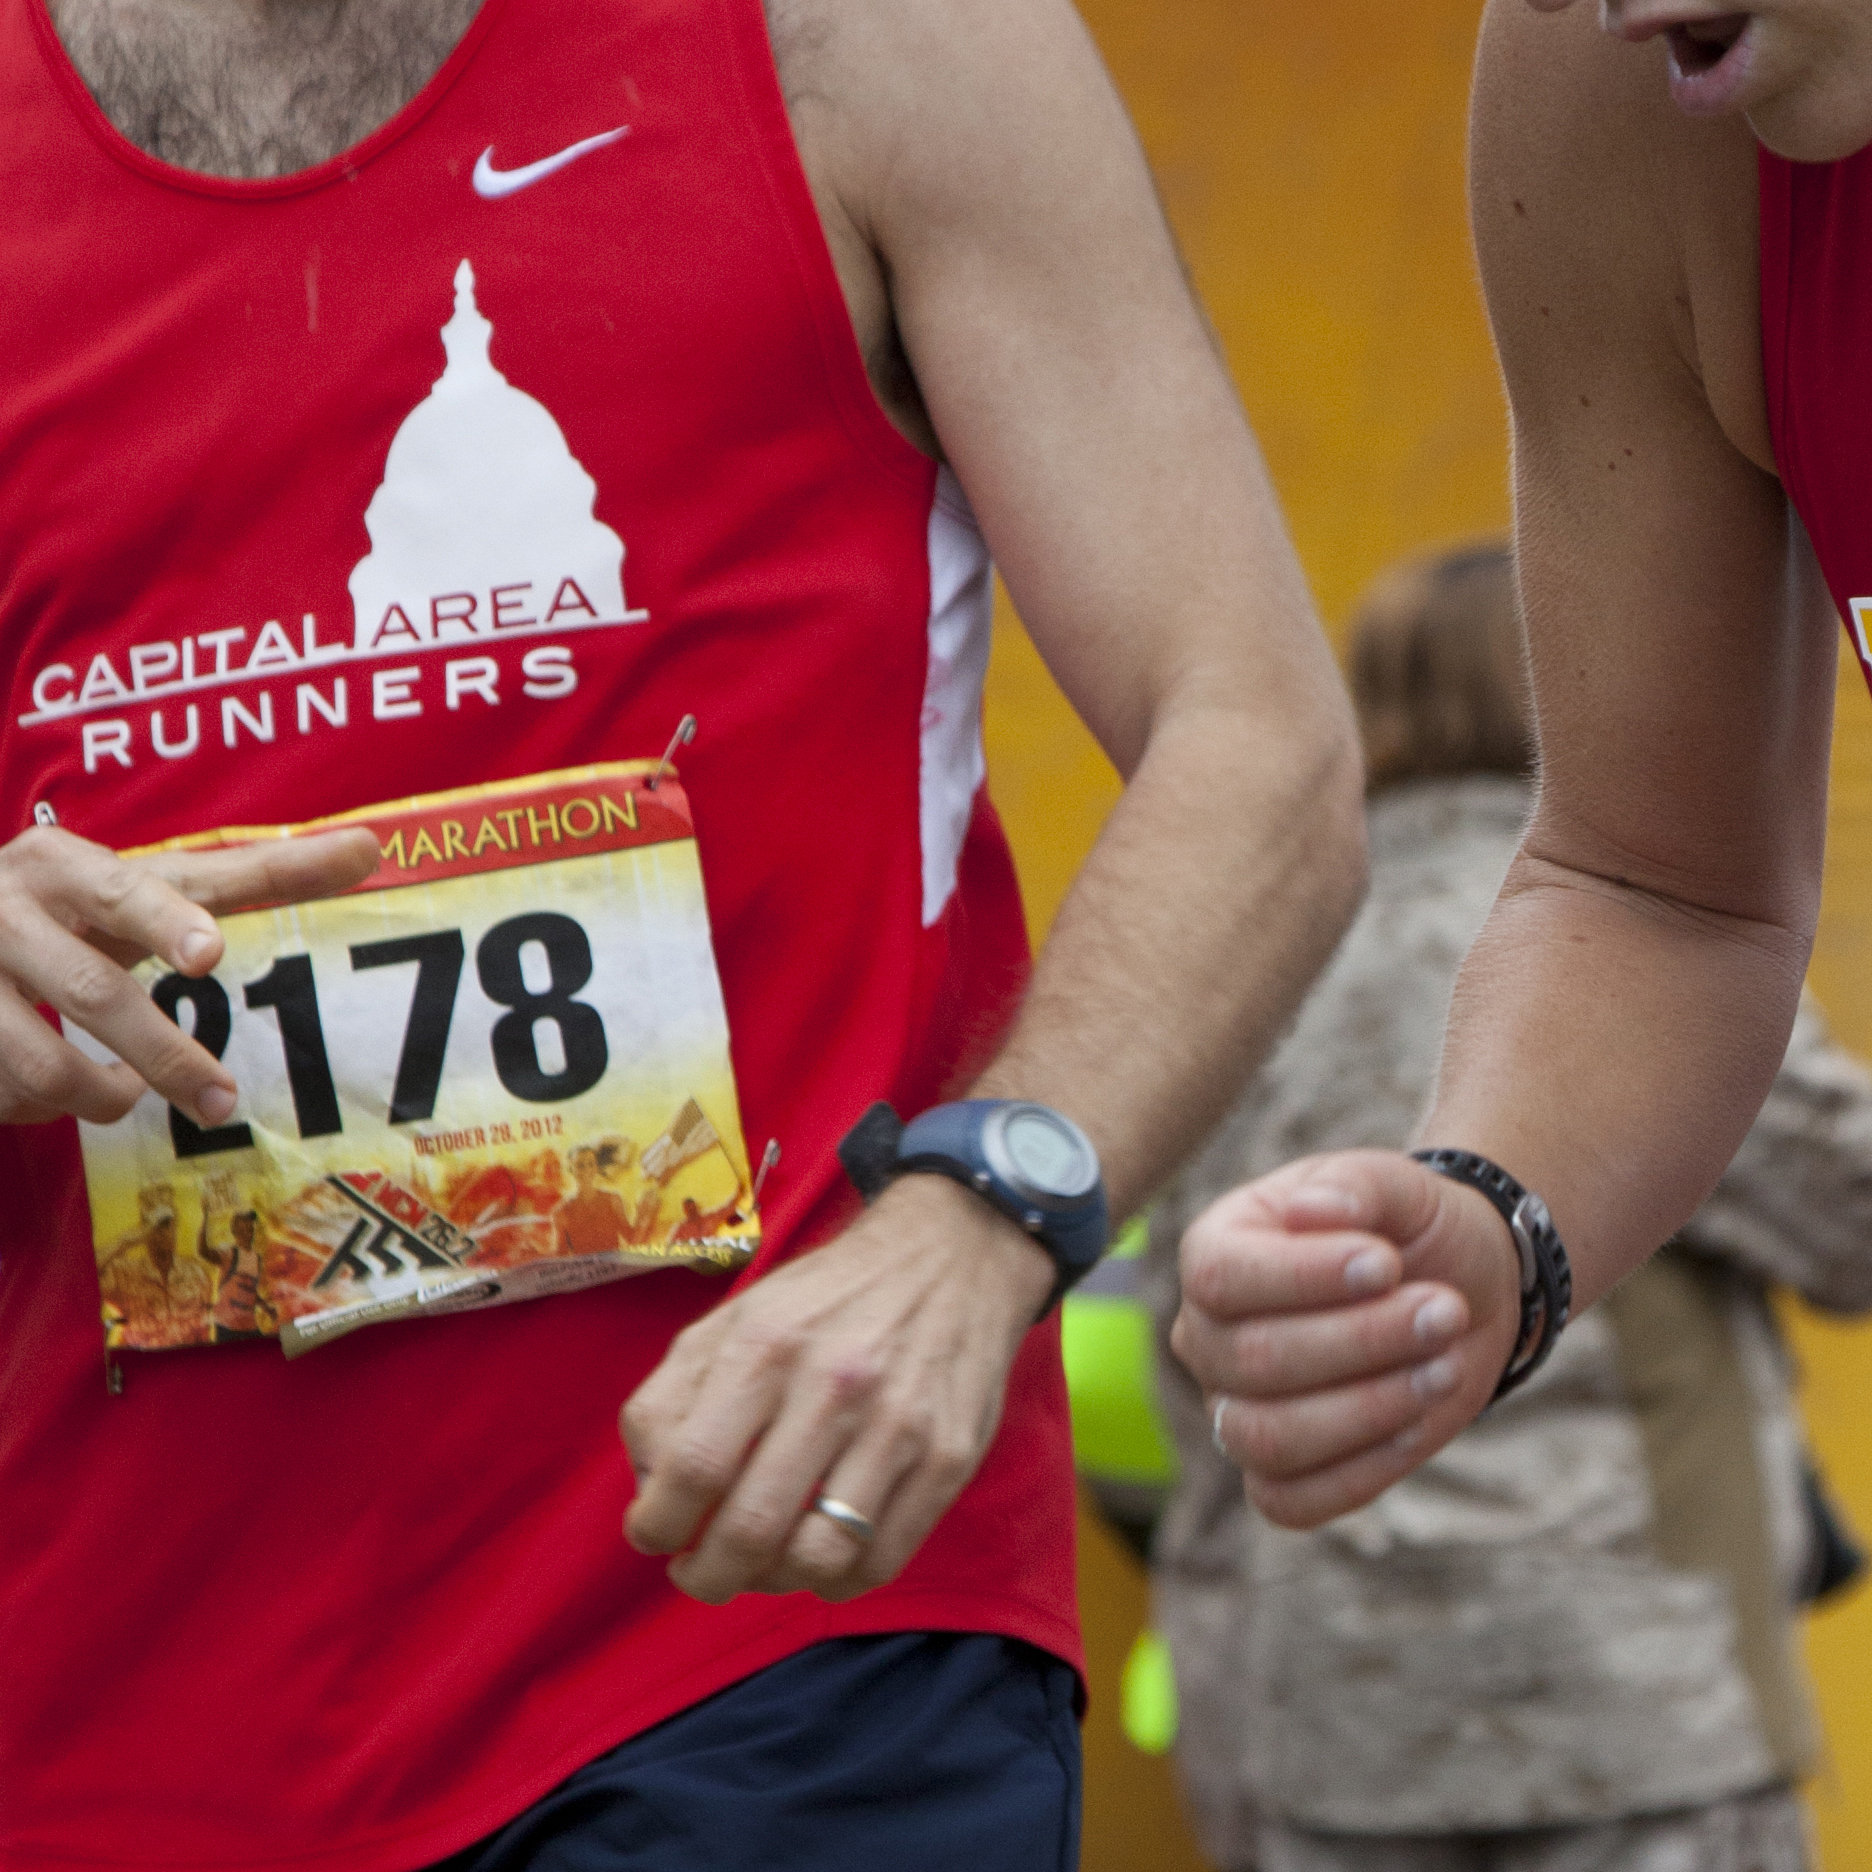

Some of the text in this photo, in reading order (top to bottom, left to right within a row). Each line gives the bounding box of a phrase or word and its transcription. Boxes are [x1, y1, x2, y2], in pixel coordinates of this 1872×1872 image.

[31, 576, 599, 714] CAPITAL AREA
[81, 646, 578, 773] RUNNERS
[380, 789, 639, 869] MARATHON
[150, 911, 609, 1159] 2178
[413, 1124, 486, 1157] OCTOBER
[519, 1113, 564, 1141] 2012
